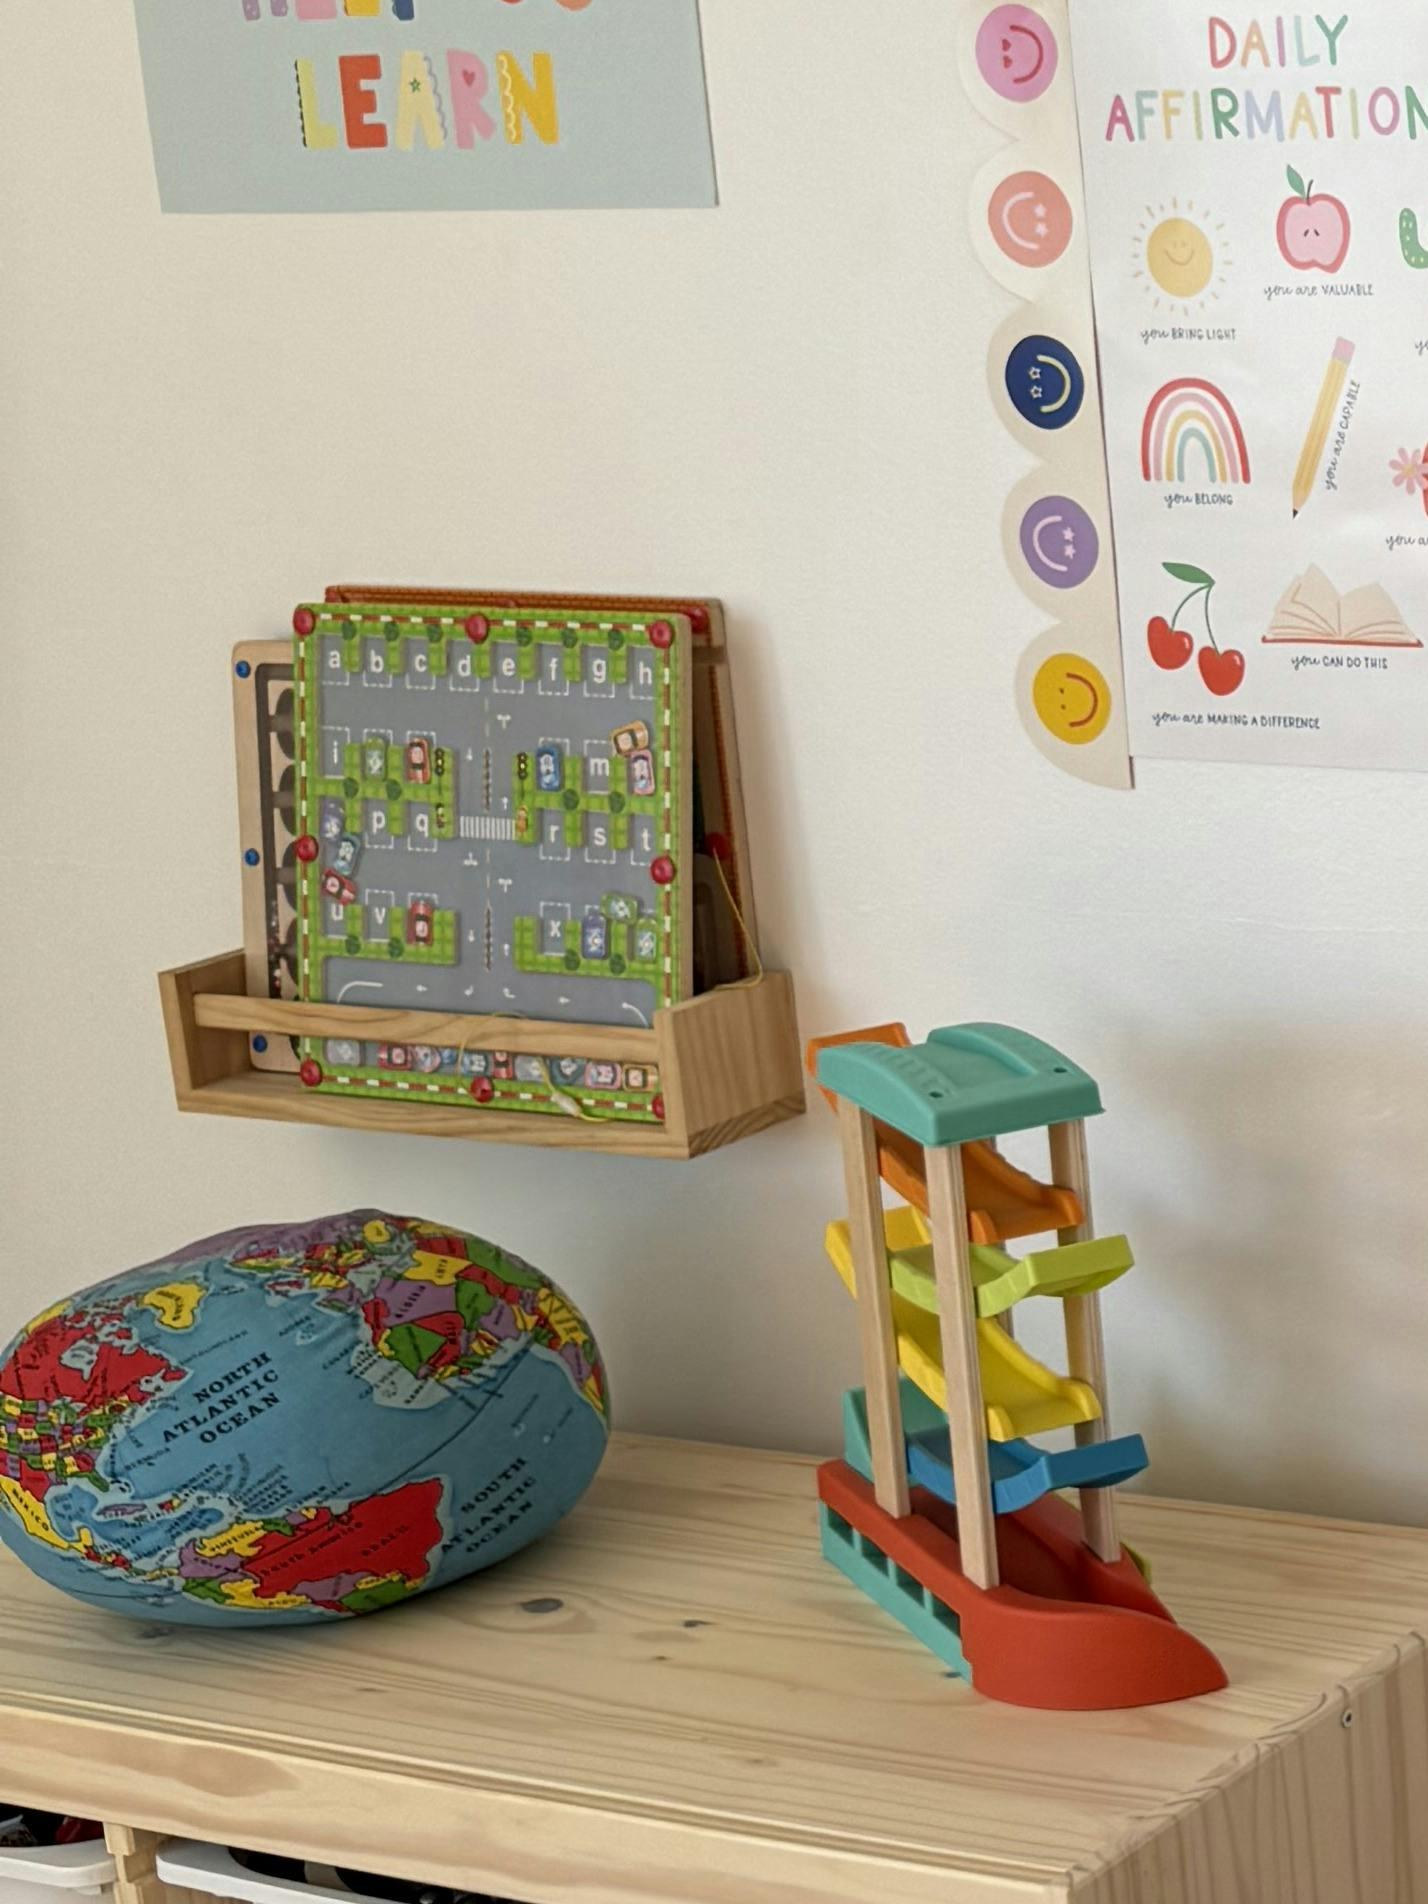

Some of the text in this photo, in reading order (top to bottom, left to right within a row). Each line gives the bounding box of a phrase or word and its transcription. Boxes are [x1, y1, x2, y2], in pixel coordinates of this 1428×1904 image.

[1208, 14, 1348, 69] DAILY
[294, 50, 559, 151] LEARN
[1264, 283, 1374, 300] you are VALUABLE
[1141, 327, 1236, 343] you BRING LIGHT
[1325, 458, 1338, 491] you
[1342, 380, 1361, 430] CAPABLE
[1164, 492, 1233, 509] you BELONG
[1386, 536, 1415, 551] you
[328, 649, 652, 685] a b c d e f g h
[1291, 655, 1388, 671] you CAN DO THIS
[1152, 712, 1320, 729] you are MAKING A DIFFERENCE
[589, 757, 609, 777] m
[371, 810, 429, 838] p q
[549, 825, 651, 852] r s t
[374, 907, 386, 925] v
[550, 919, 561, 938] x
[192, 1351, 272, 1404] NORTH
[162, 1369, 279, 1444] ATLANTIC
[200, 1392, 281, 1444] OCEAN
[461, 1457, 528, 1514] SOUTH
[12, 1488, 50, 1532] MEXICO
[441, 1476, 537, 1554] ATLANTIC
[466, 1500, 533, 1553] OCEAN
